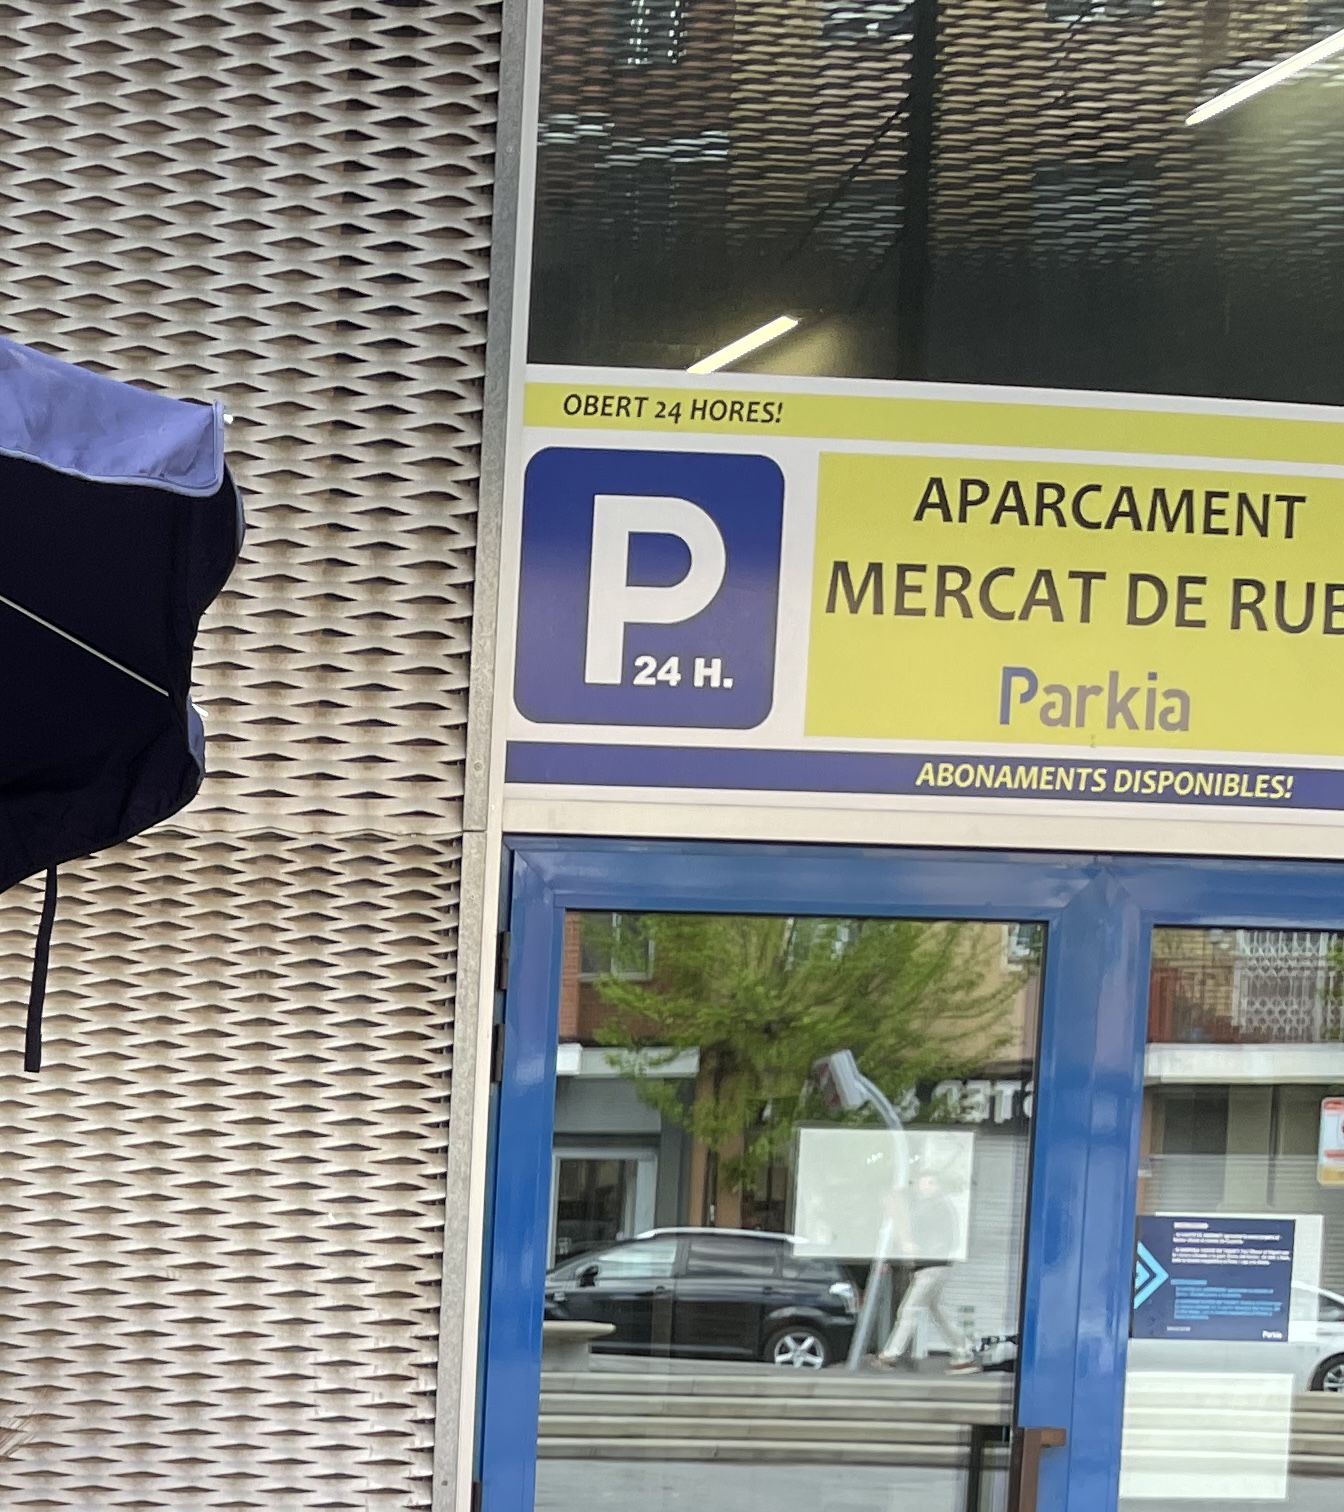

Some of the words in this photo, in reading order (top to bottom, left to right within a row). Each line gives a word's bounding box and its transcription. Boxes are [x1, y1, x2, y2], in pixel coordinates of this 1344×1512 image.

[563, 393, 648, 419] OBERT
[655, 398, 682, 423] 24
[690, 398, 784, 424] HORES!
[913, 477, 1307, 539] APARCAMENT
[585, 494, 727, 685] P
[825, 562, 1106, 623] MERCAT
[1124, 574, 1208, 628] DE
[634, 655, 683, 685] 24
[693, 659, 733, 688] H.
[999, 666, 1190, 732] Parkia
[916, 761, 1106, 793] ABONAMENTS
[1114, 769, 1293, 799] DISPONIBLES!
